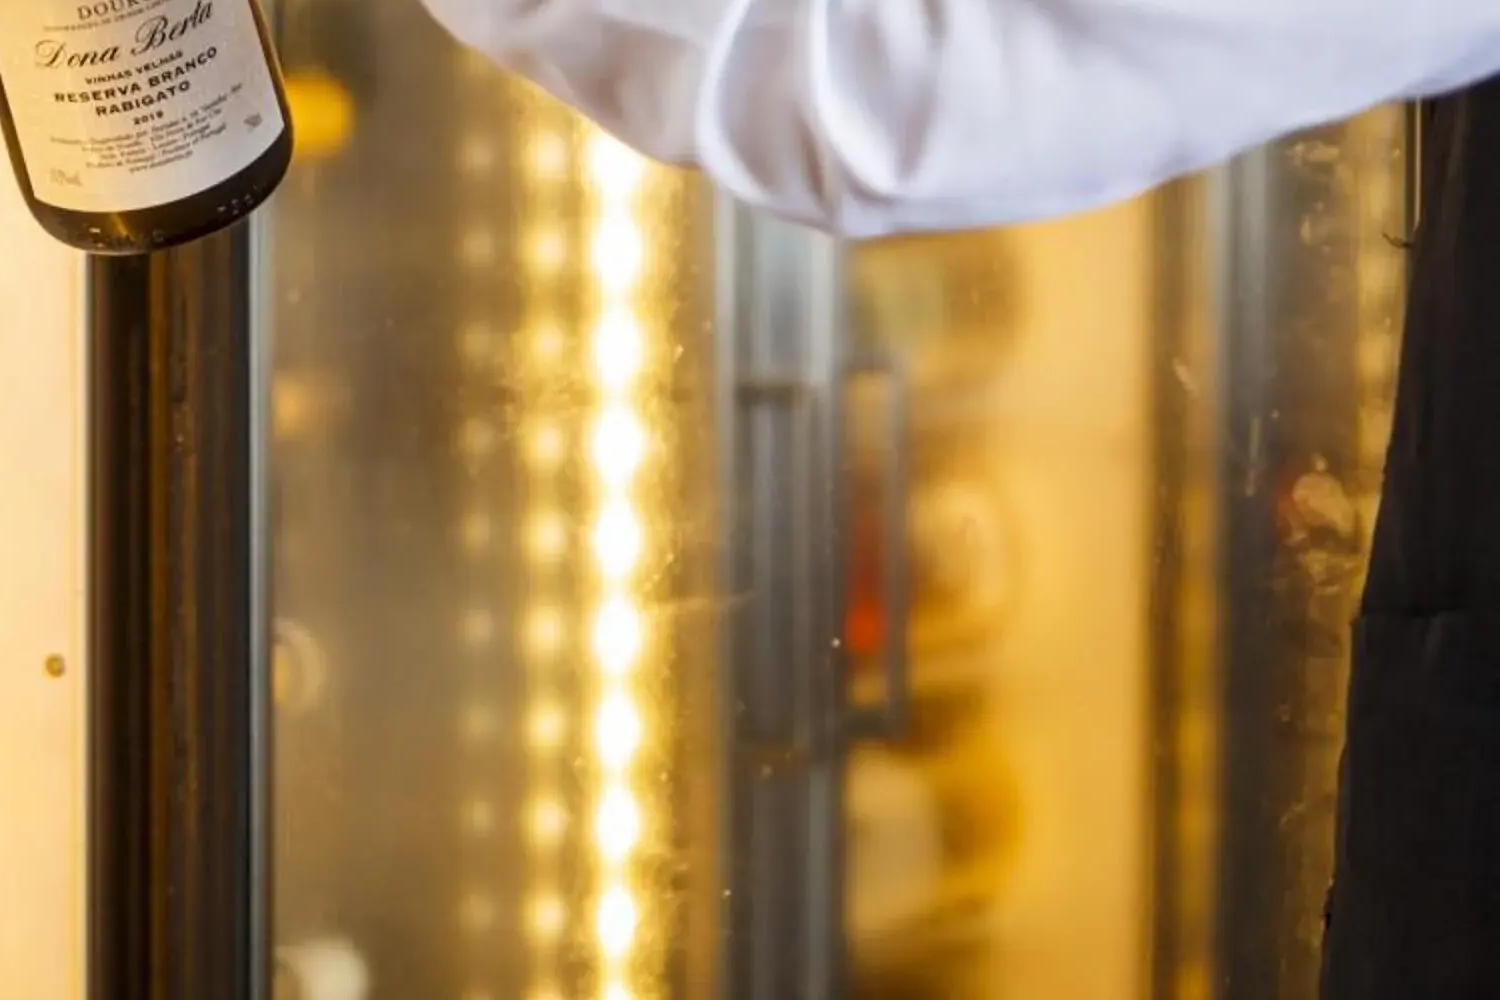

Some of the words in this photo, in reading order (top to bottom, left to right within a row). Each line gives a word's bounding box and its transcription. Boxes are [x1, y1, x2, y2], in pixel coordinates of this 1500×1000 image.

[35, 39, 120, 69] Dona
[85, 68, 133, 85] VINHAS
[135, 50, 184, 75] VELHAS
[54, 82, 142, 103] RESERVA
[148, 46, 218, 87] BRANCO
[95, 80, 191, 117] RABIGATO
